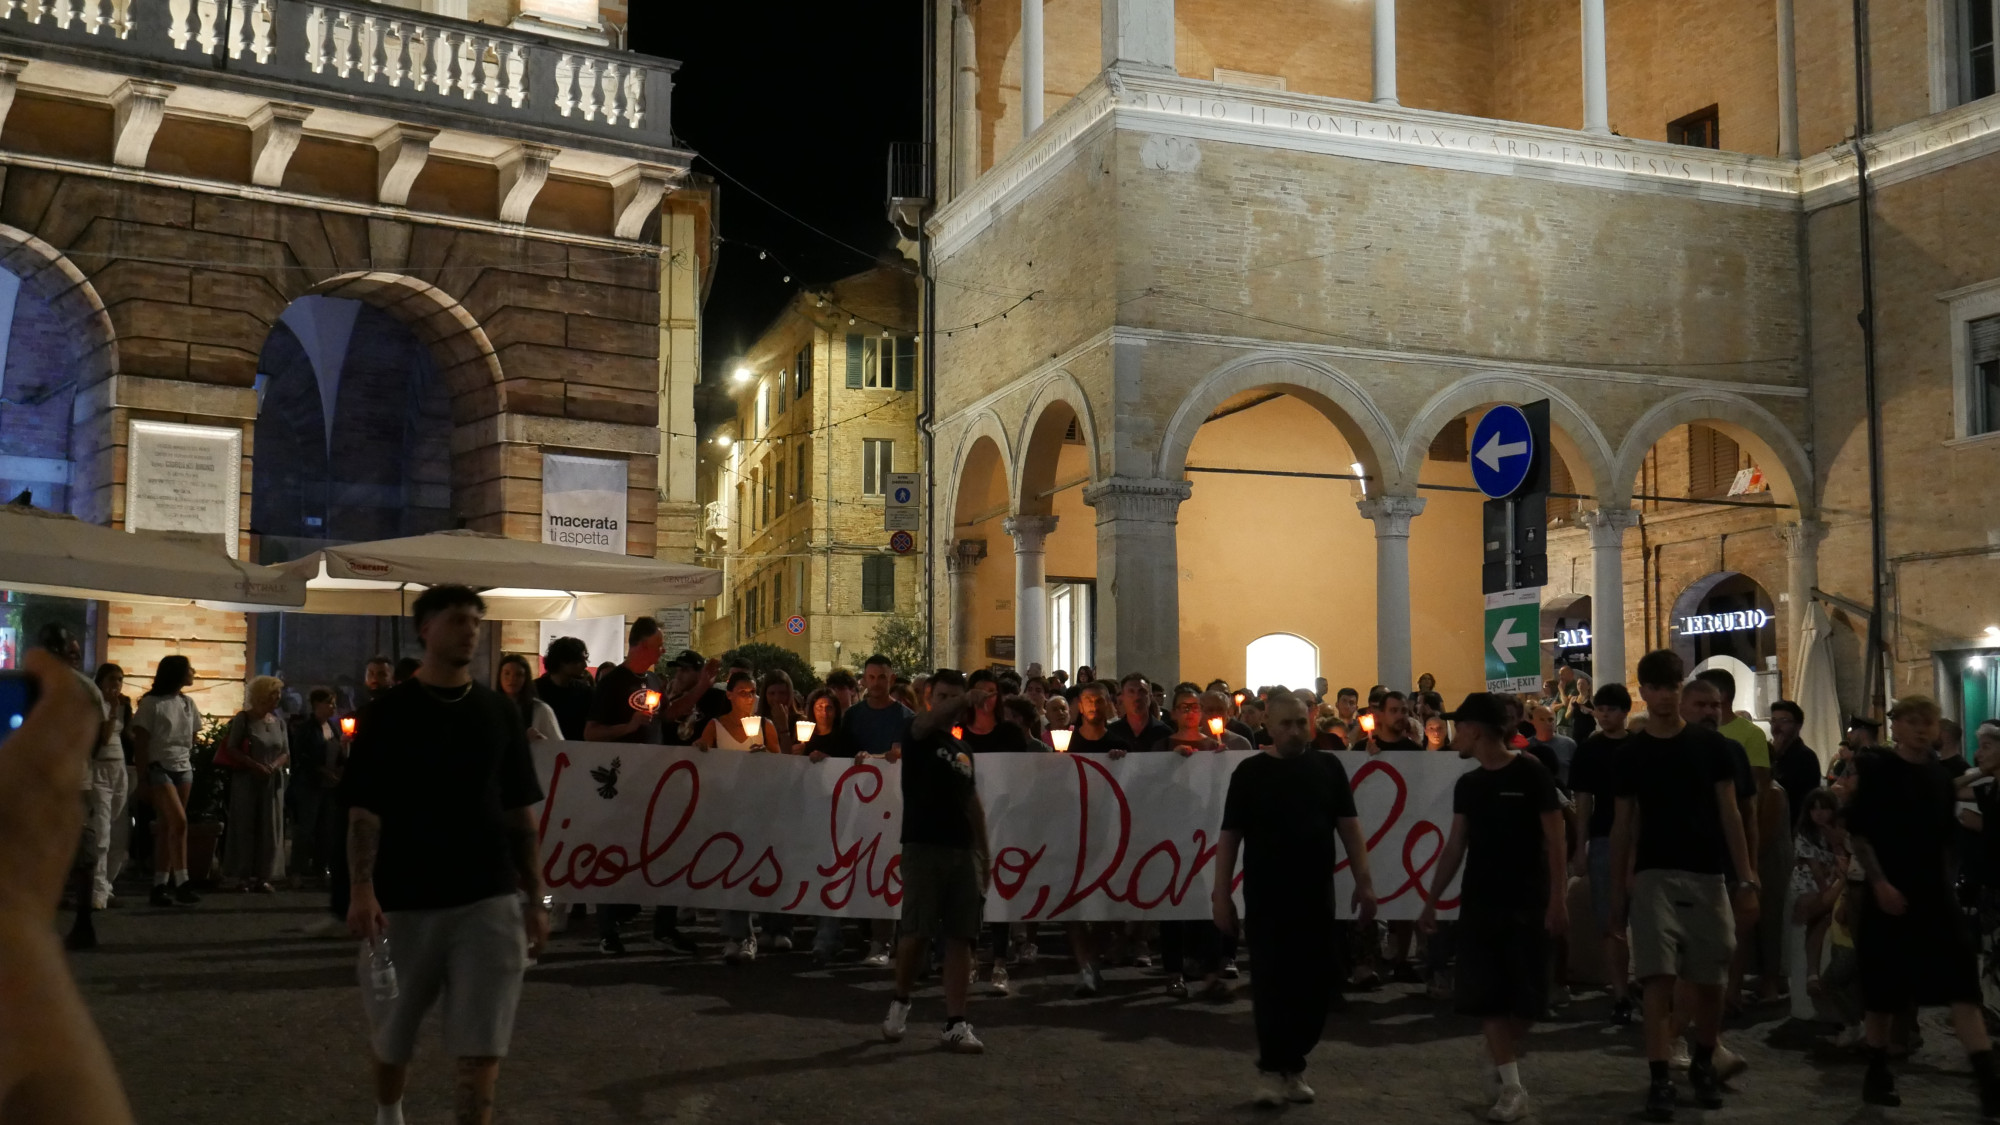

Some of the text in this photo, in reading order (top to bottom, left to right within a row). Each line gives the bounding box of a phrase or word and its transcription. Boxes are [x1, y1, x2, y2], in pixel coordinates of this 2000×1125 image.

[1289, 112, 1363, 136] PONT
[1387, 124, 1446, 147] MAX
[1467, 136, 1541, 159] CARD
[550, 515, 617, 530] macerata
[550, 528, 609, 546] ti aspetta
[1679, 609, 1767, 635] MERCURIO
[1558, 629, 1588, 647] BAR
[1517, 677, 1536, 689] EXIT
